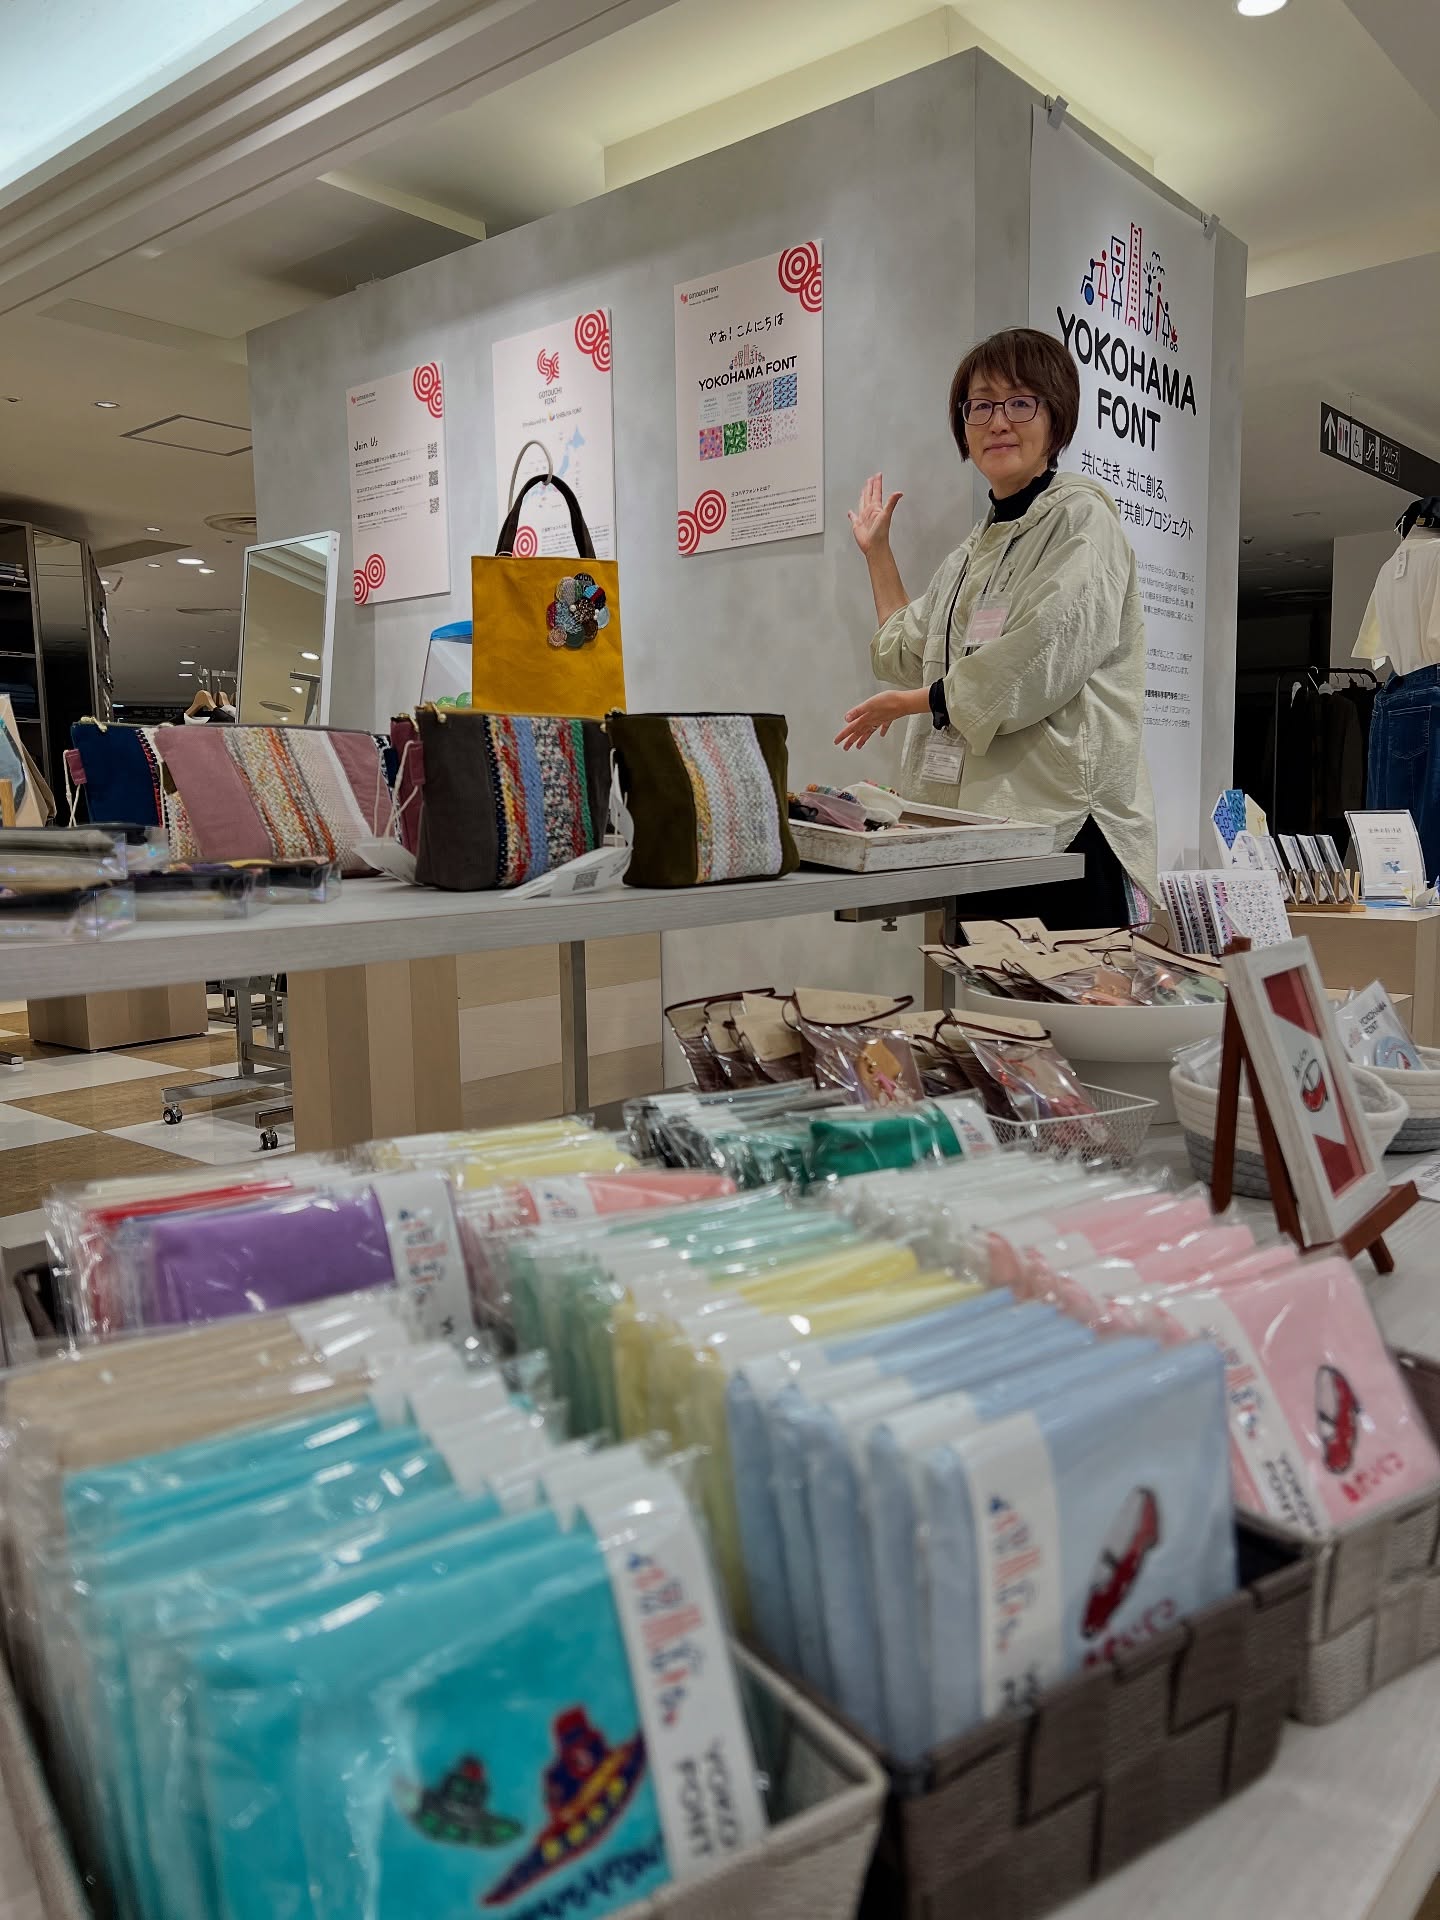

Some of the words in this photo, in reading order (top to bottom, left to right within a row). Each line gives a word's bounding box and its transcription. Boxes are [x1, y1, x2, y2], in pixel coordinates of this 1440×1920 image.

[737, 312, 784, 337] こんにちは
[699, 365, 764, 391] YOKOHAMA
[766, 355, 797, 375] FONT
[1057, 306, 1197, 416] YOKOHAMA
[1098, 388, 1161, 451] FONT
[354, 441, 368, 451] Join
[370, 436, 378, 447] Us
[1082, 449, 1167, 502] 共に生き、共に創る、
